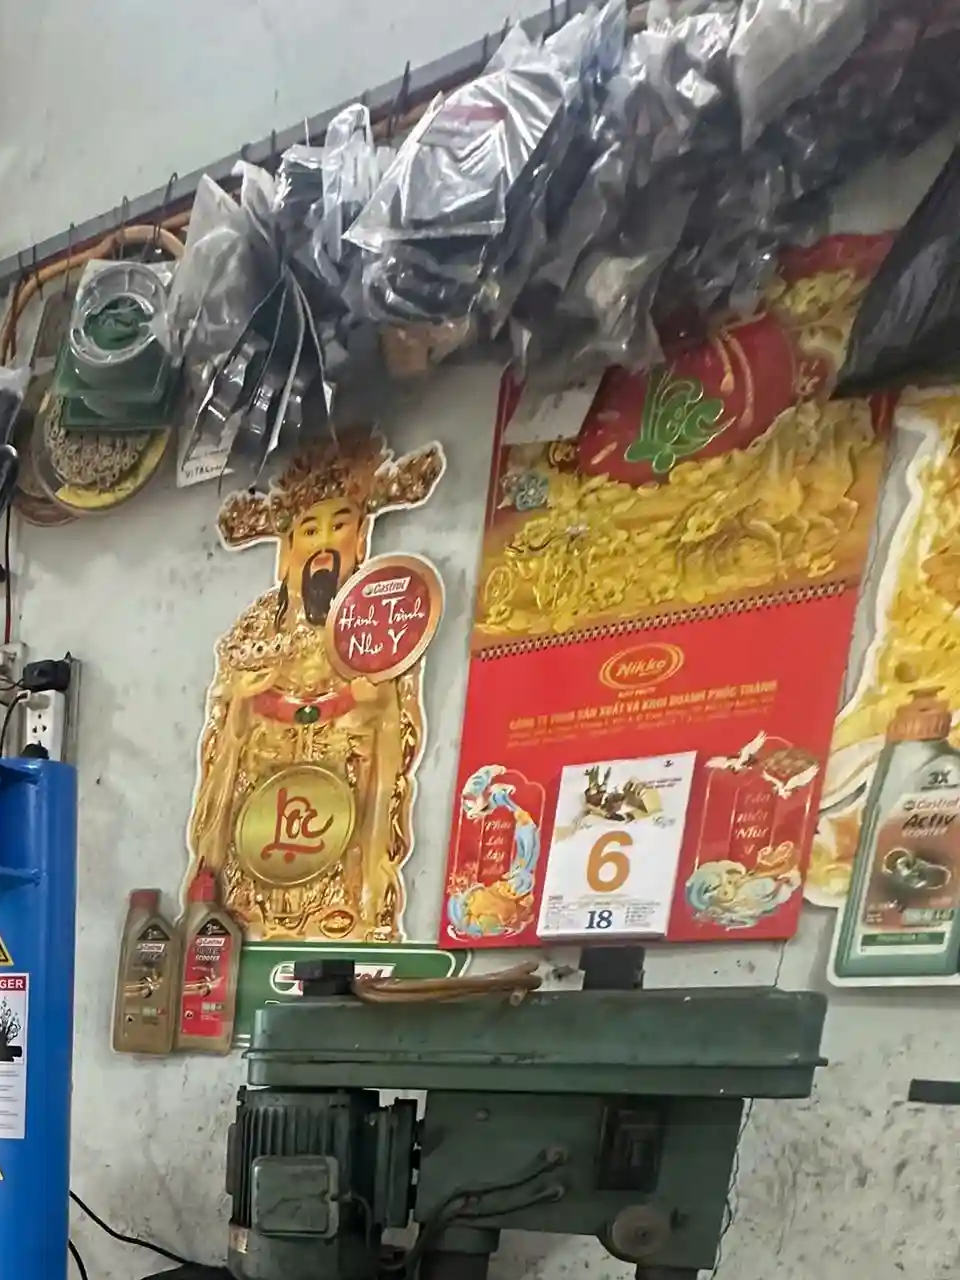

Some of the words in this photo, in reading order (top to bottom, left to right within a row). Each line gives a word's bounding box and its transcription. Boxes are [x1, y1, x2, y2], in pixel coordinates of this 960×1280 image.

[373, 579, 407, 595] Castrol
[348, 632, 384, 660] Như
[387, 623, 409, 656] Ý
[616, 658, 668, 678] Nikko
[260, 787, 334, 864] Lộc
[586, 830, 634, 893] 6
[585, 909, 613, 930] 18
